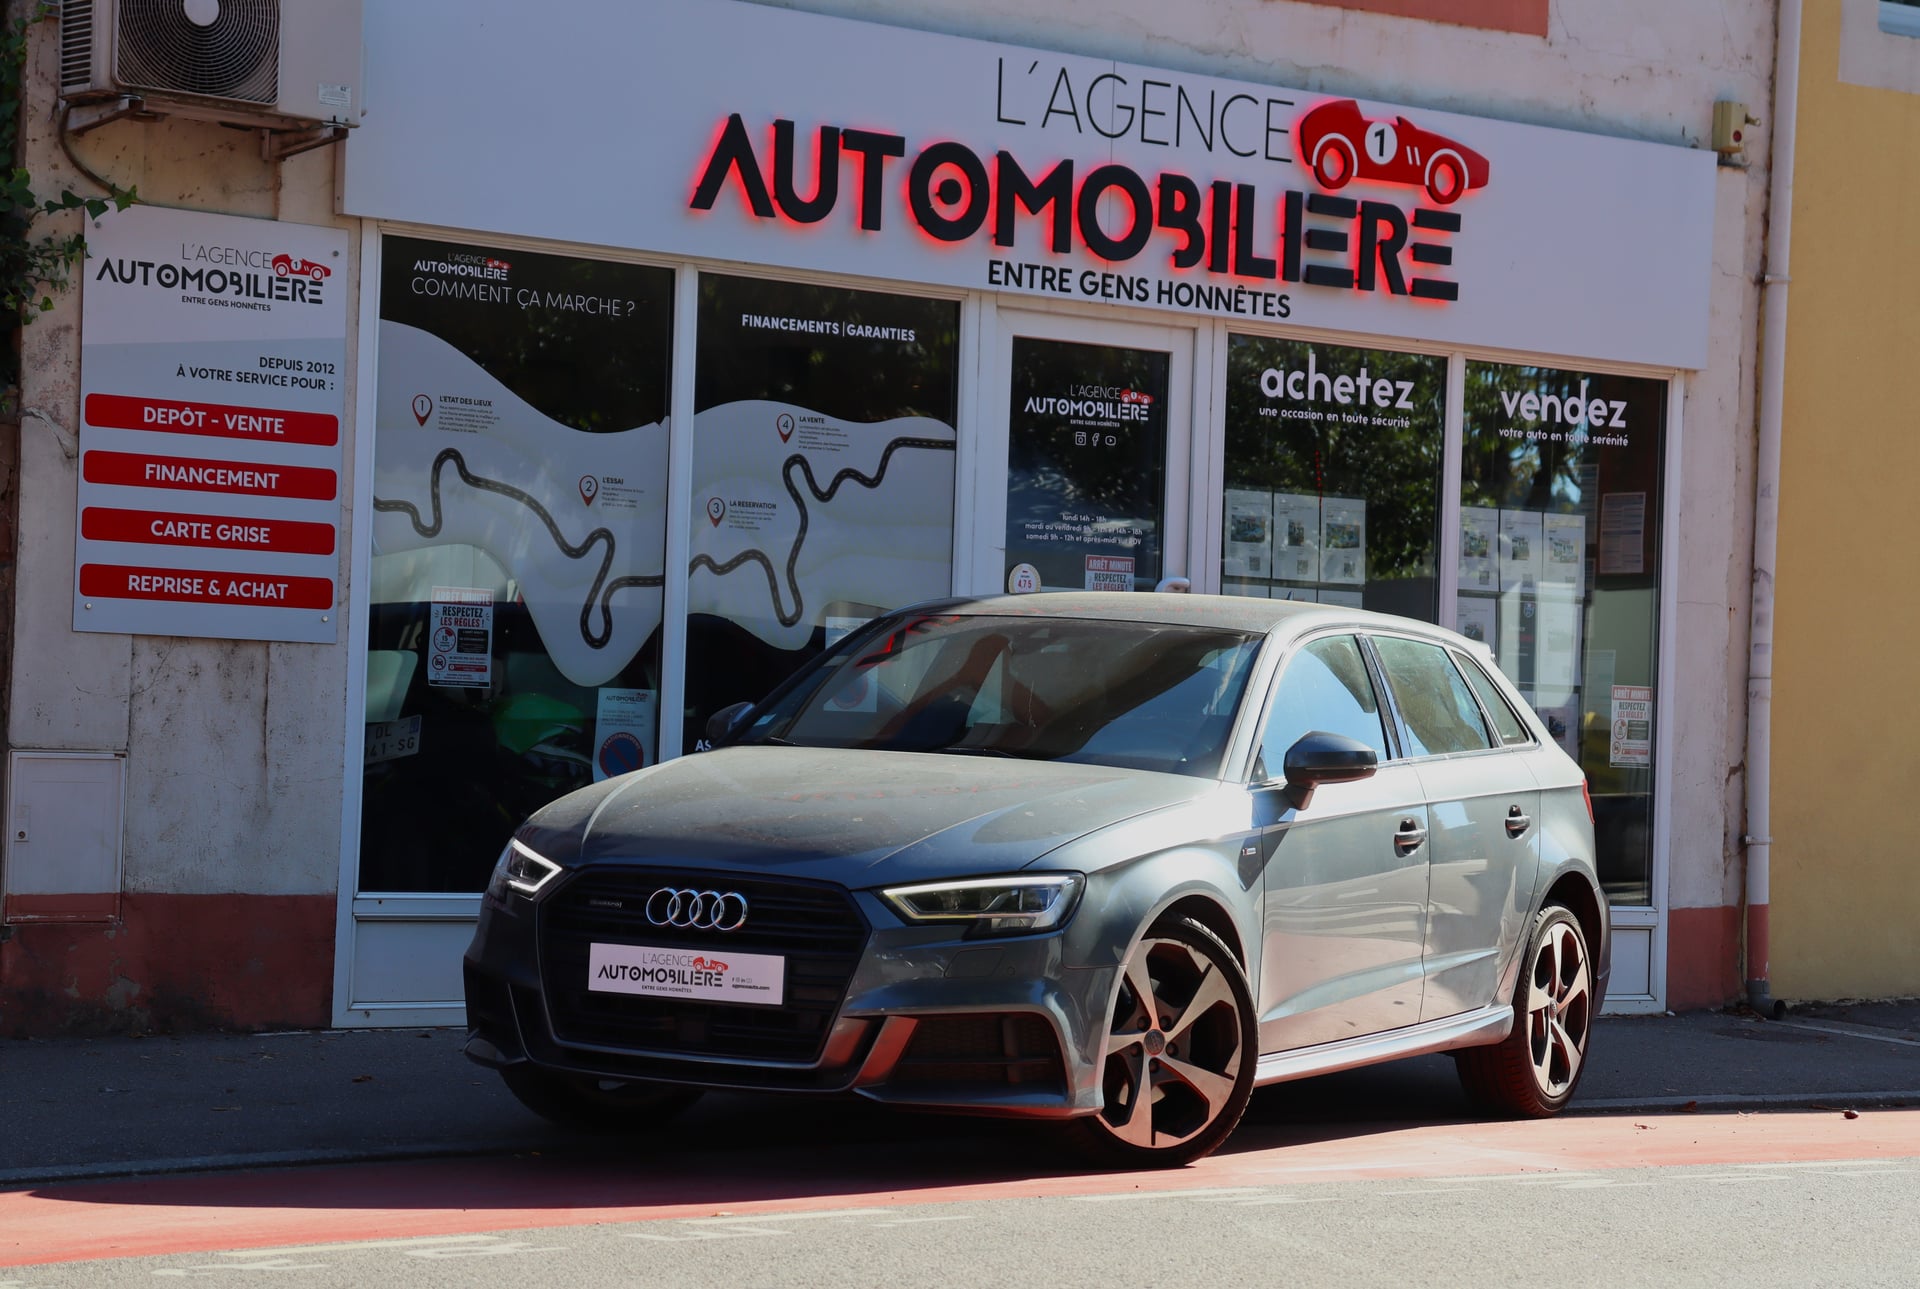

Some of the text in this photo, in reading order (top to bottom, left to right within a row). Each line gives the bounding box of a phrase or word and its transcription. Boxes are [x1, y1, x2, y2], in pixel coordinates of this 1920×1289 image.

[997, 57, 1296, 164] L'AGENCE
[1372, 128, 1389, 159] 1
[181, 243, 272, 270] L'AGENCE
[411, 276, 635, 317] COMMENT ÇA MARCHE ?
[988, 259, 1292, 319] ENTRE GENS HONNÊTES
[181, 295, 271, 312] ENTRE GENS HONNÊTES
[742, 314, 915, 342] FINANCEMENTS GARANTIES
[259, 356, 335, 375] DEPUIS 2012
[176, 363, 335, 391] À VOTRE SERVICE POUR :
[1260, 352, 1415, 410] achetez
[1070, 384, 1121, 399] L'AGENCE
[460, 397, 473, 405] DES
[473, 399, 492, 408] LIEUX
[1500, 379, 1628, 428] vendez
[143, 406, 206, 427] DEPÔT
[224, 413, 285, 435] VENTE
[782, 419, 790, 430] 4
[799, 415, 825, 425] LA VENTE
[1259, 407, 1410, 429] une occasion en toute sécurité
[1499, 427, 1523, 439] votre
[1526, 428, 1548, 441] auto
[1550, 432, 1562, 442] en
[1564, 430, 1590, 444] toute
[144, 463, 279, 490] FINANCEMENT
[584, 480, 593, 492] 2
[712, 502, 720, 514] 3
[729, 499, 737, 507] LA
[1062, 513, 1079, 521] lundi
[1080, 514, 1090, 522] 14h
[150, 520, 270, 544] CARTE GRISE
[1053, 524, 1082, 532] vendredi
[1116, 527, 1126, 535] 14h
[1132, 528, 1143, 536] 18h
[1025, 533, 1049, 541] samedi
[1064, 534, 1075, 542] 12h
[1083, 536, 1117, 545] après-midi
[1109, 560, 1133, 572] MINUTE
[1094, 572, 1127, 583] RESPECTEZ
[127, 574, 289, 600] REPRISE & ACHAT
[460, 592, 491, 604] MINUTE
[442, 606, 484, 618] RESPECTEZ
[440, 617, 453, 627] LES
[1618, 701, 1646, 711] RESPECTEZ
[642, 952, 693, 967] L'AGENCE
